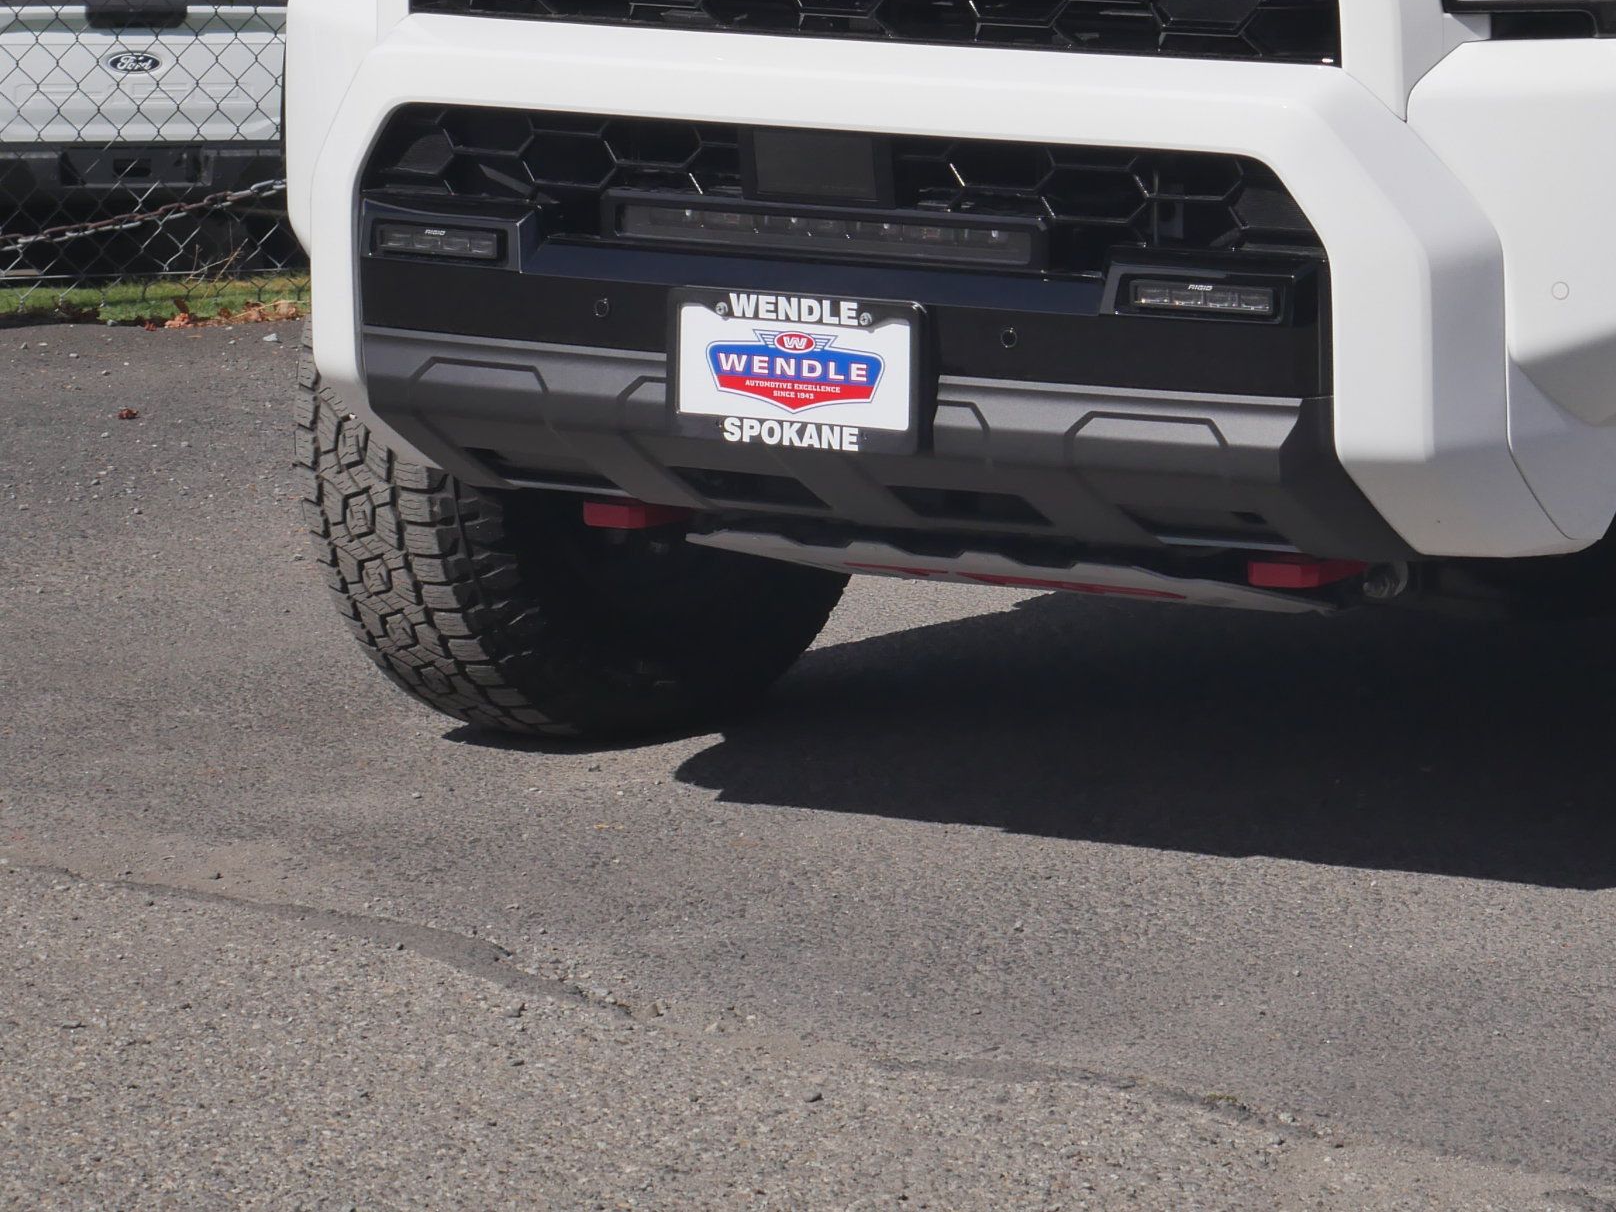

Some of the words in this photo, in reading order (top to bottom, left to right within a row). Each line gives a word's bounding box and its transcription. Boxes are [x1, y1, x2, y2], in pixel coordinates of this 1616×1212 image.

[116, 55, 153, 70] Ford
[729, 293, 859, 326] WENDLE
[718, 352, 867, 382] WENDLE
[745, 379, 793, 390] AUTOMOTIVE
[794, 383, 841, 393] EXCELLENCE
[723, 417, 859, 452] SPOKANE
